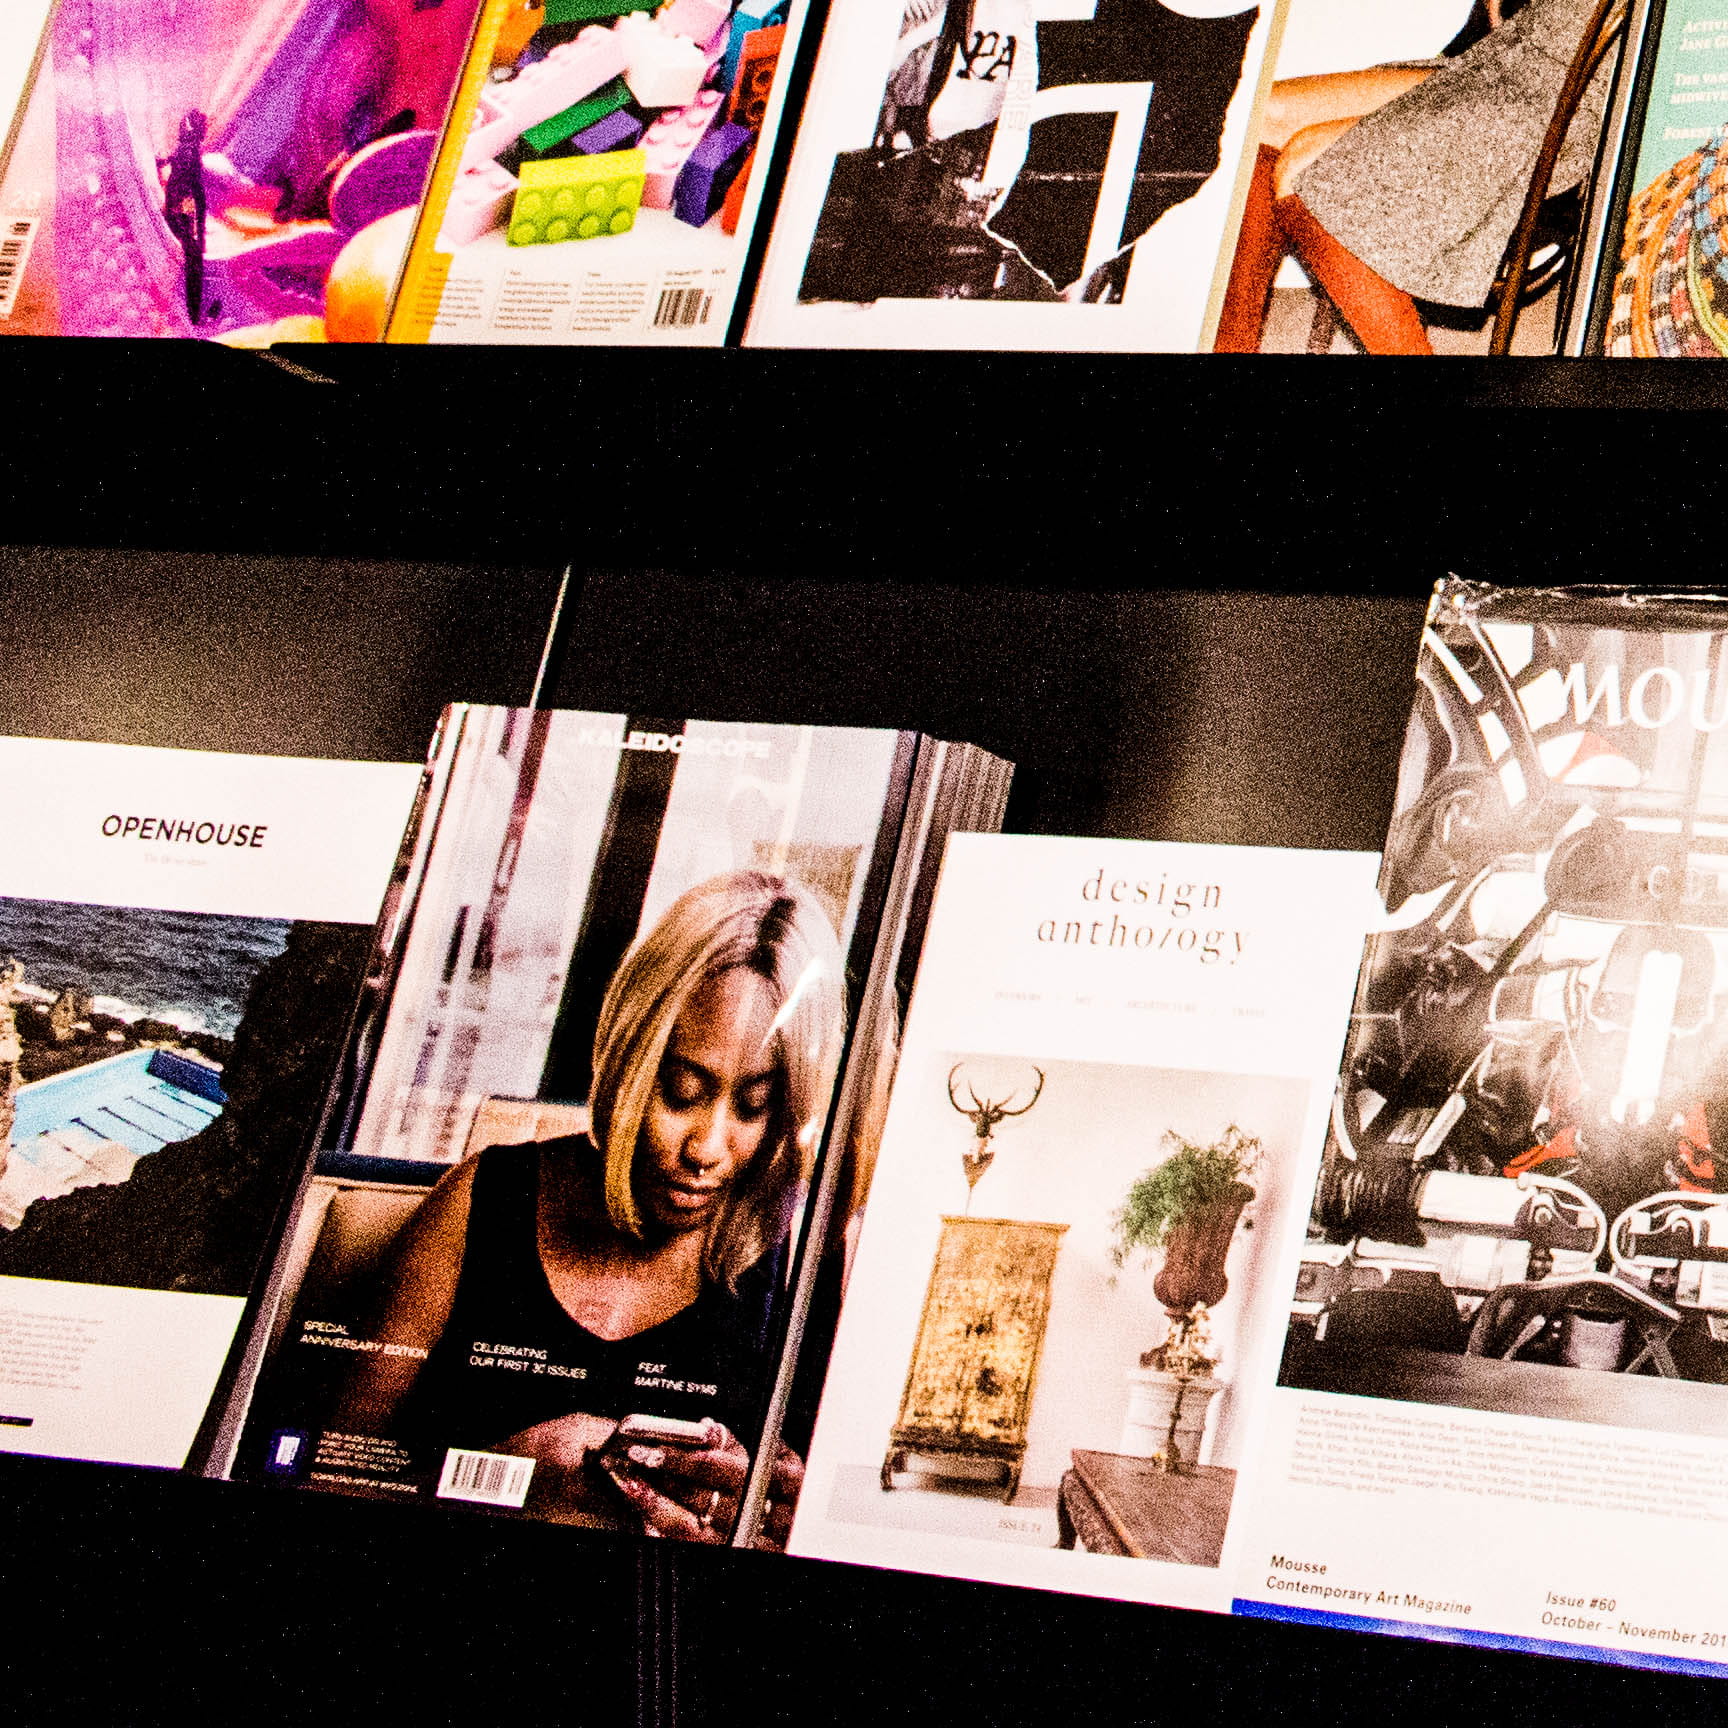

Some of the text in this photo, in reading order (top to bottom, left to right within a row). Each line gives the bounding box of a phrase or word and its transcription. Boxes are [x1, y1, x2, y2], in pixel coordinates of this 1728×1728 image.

[578, 727, 770, 759] KALEIDOSCOPE
[102, 814, 268, 849] OPENHOUSE
[1082, 868, 1222, 919] design
[1036, 914, 1252, 965] anthology
[303, 1320, 349, 1336] SPECIAL
[472, 1340, 548, 1361] CELEBRATING
[468, 1354, 497, 1368] OUR
[496, 1357, 530, 1373] FIRST
[546, 1364, 588, 1381] ISSUES
[634, 1375, 685, 1393] MARTINE
[1270, 1553, 1328, 1576] Mousse
[1265, 1574, 1472, 1616] Contemporary Art Magazine
[1545, 1590, 1617, 1613] Issue #60
[1541, 1610, 1602, 1633] October
[1616, 1619, 1697, 1647] November
